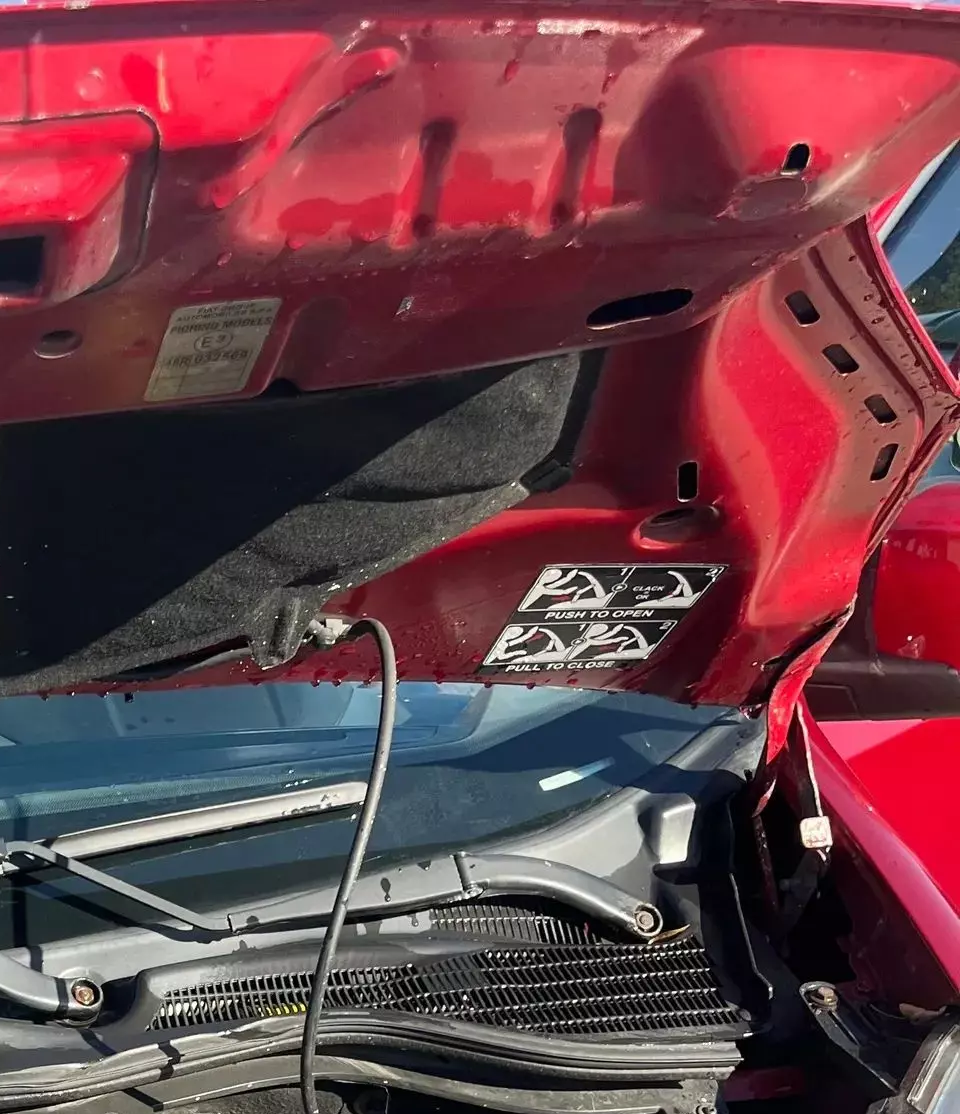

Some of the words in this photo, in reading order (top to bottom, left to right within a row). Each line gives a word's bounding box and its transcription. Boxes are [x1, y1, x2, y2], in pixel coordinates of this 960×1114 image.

[544, 610, 585, 620] PUSH
[590, 610, 609, 619] TO
[612, 609, 654, 619] OPEN
[659, 622, 673, 630] 2
[505, 664, 541, 673] PULL
[567, 661, 616, 670] CLOSE
